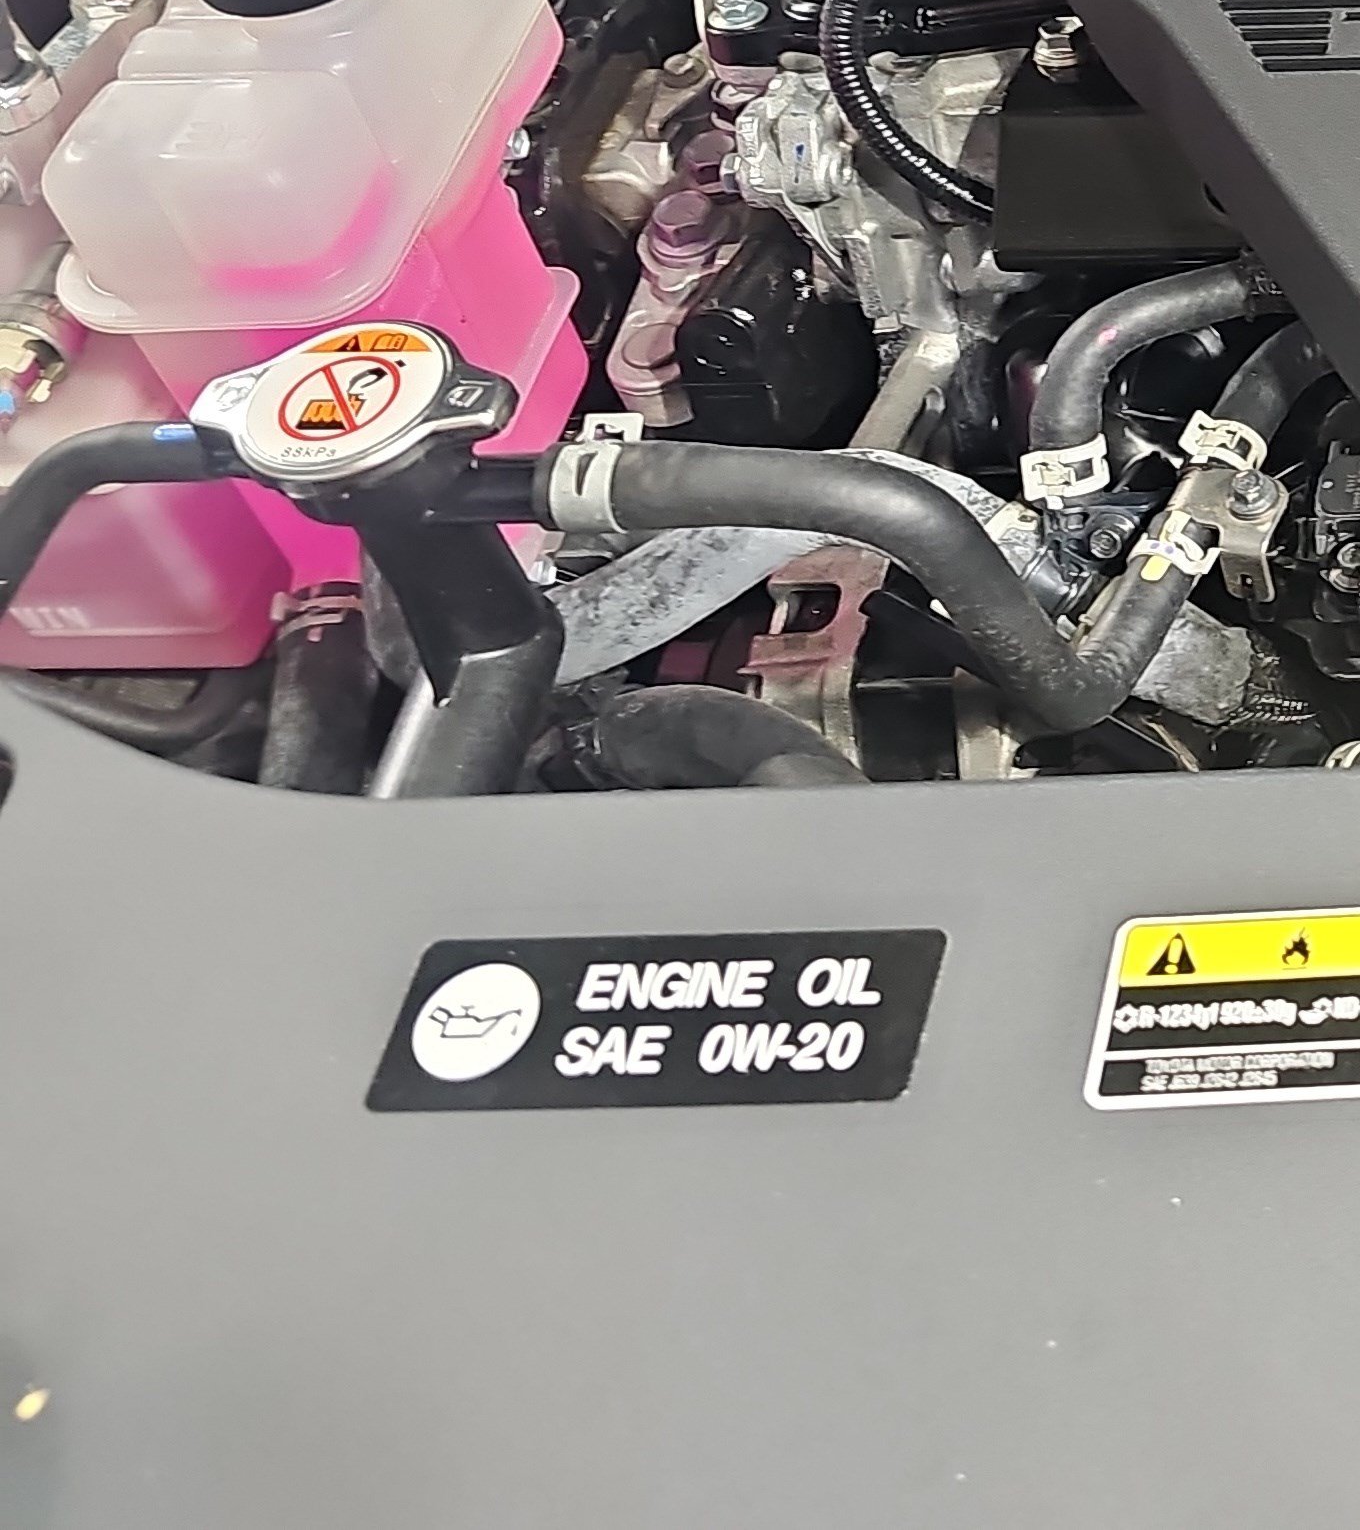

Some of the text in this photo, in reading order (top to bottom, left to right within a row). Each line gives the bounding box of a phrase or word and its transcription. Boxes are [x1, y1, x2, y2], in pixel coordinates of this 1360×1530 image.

[574, 956, 883, 1012] ENGINE OIL
[554, 1020, 867, 1077] SAE 0W-20
